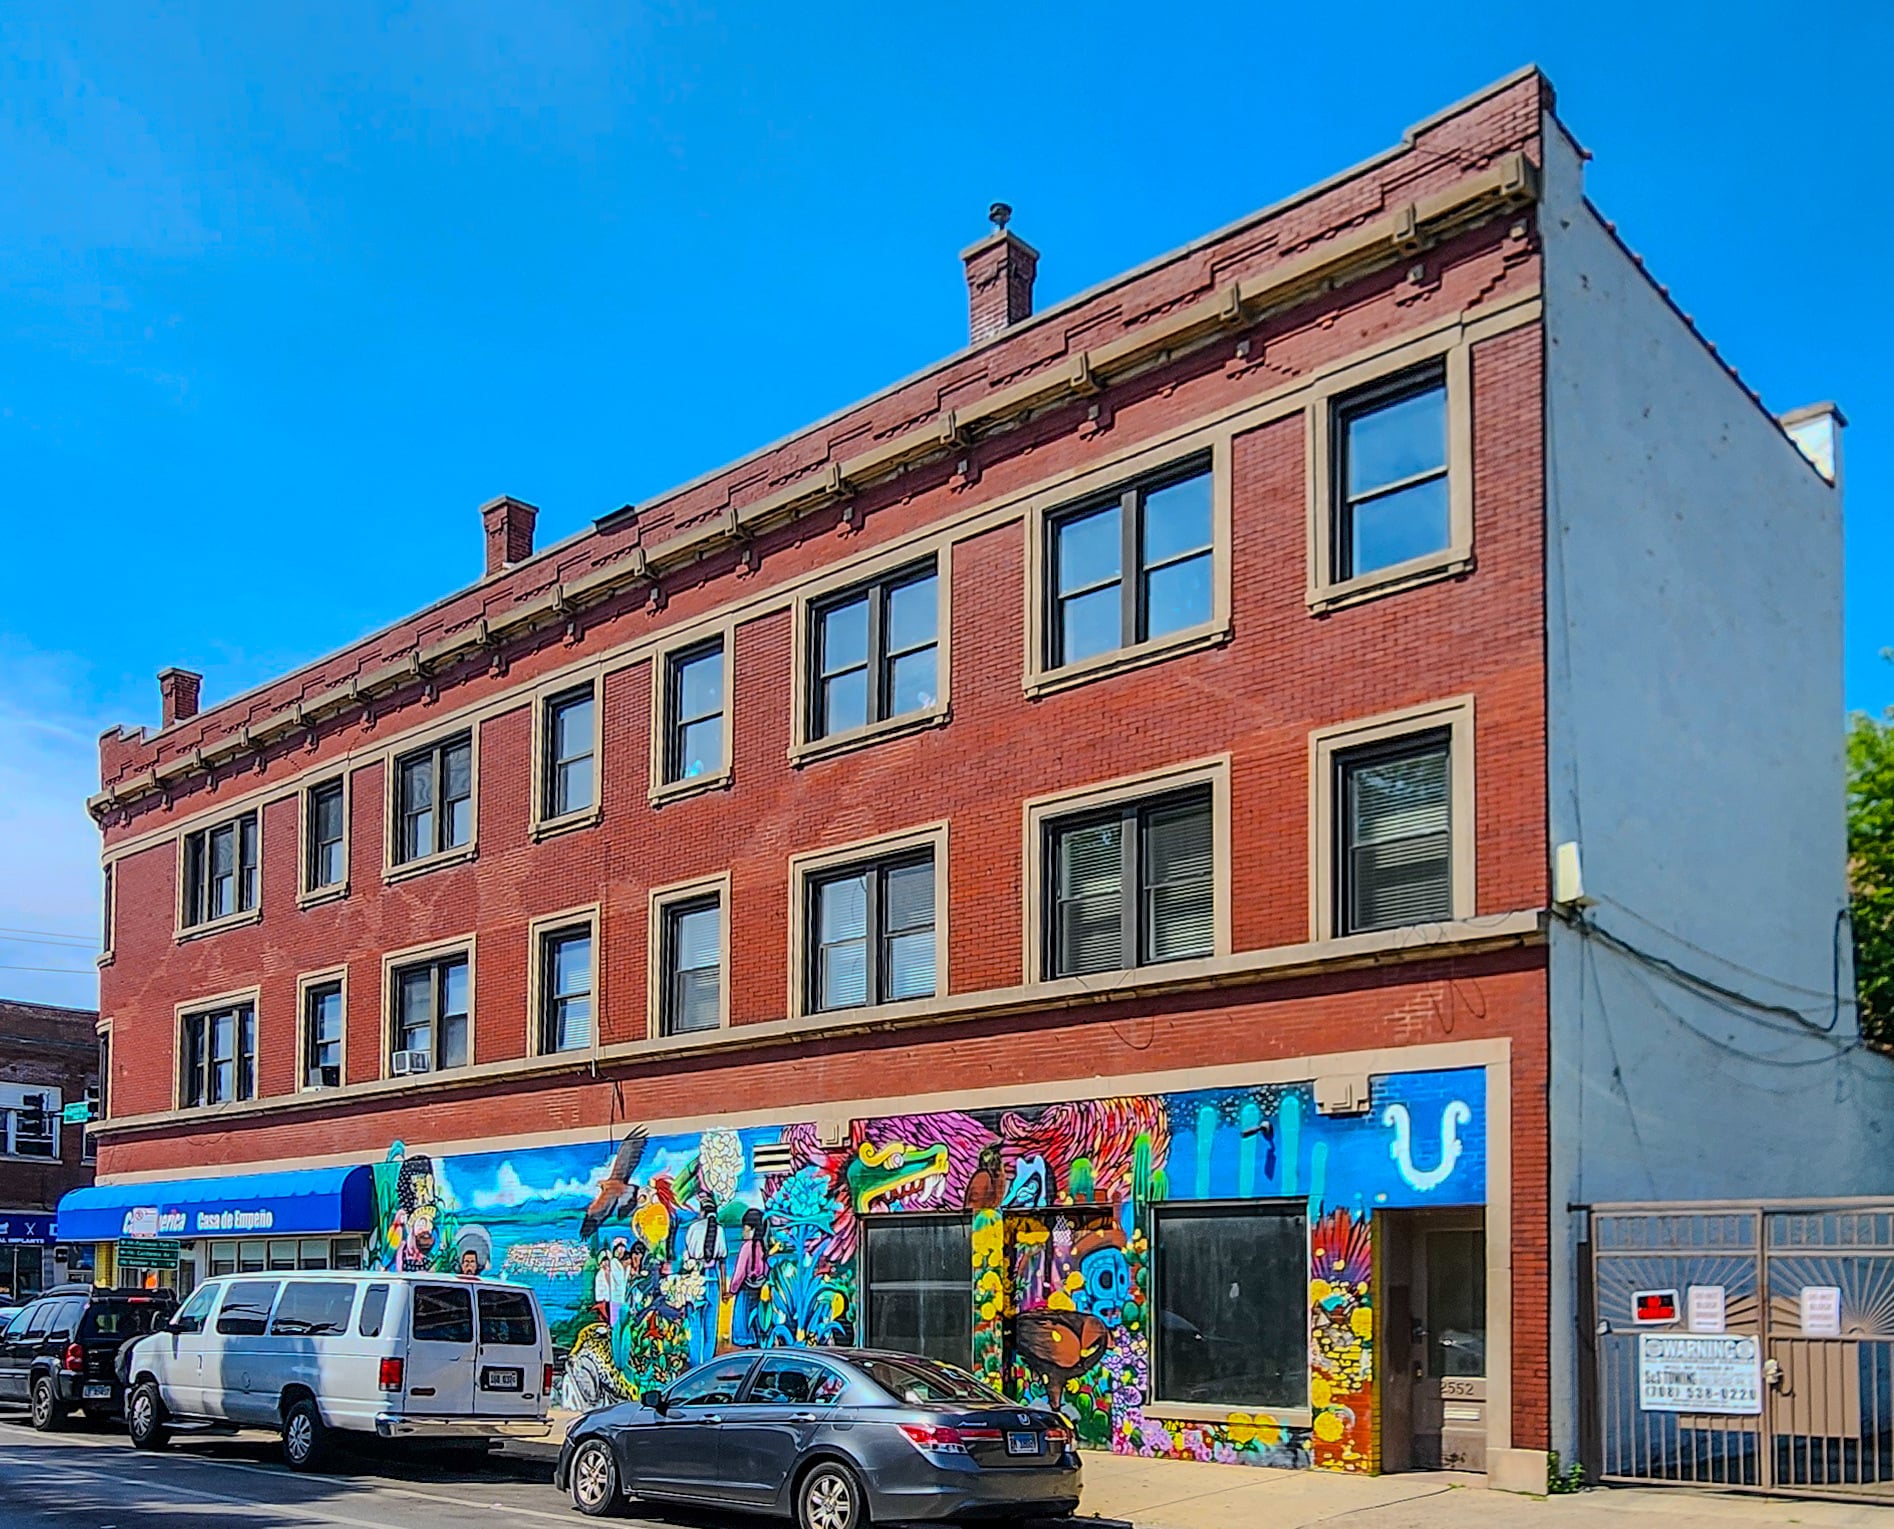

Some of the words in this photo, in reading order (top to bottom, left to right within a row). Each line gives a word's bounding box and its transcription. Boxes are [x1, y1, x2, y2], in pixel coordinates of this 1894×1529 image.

[197, 1212, 220, 1230] Casa
[221, 1211, 233, 1229] de
[234, 1209, 273, 1230] Empeño
[1663, 1339, 1736, 1359] WARNING
[1440, 1381, 1474, 1396] 2552
[1645, 1386, 1680, 1398] (708)
